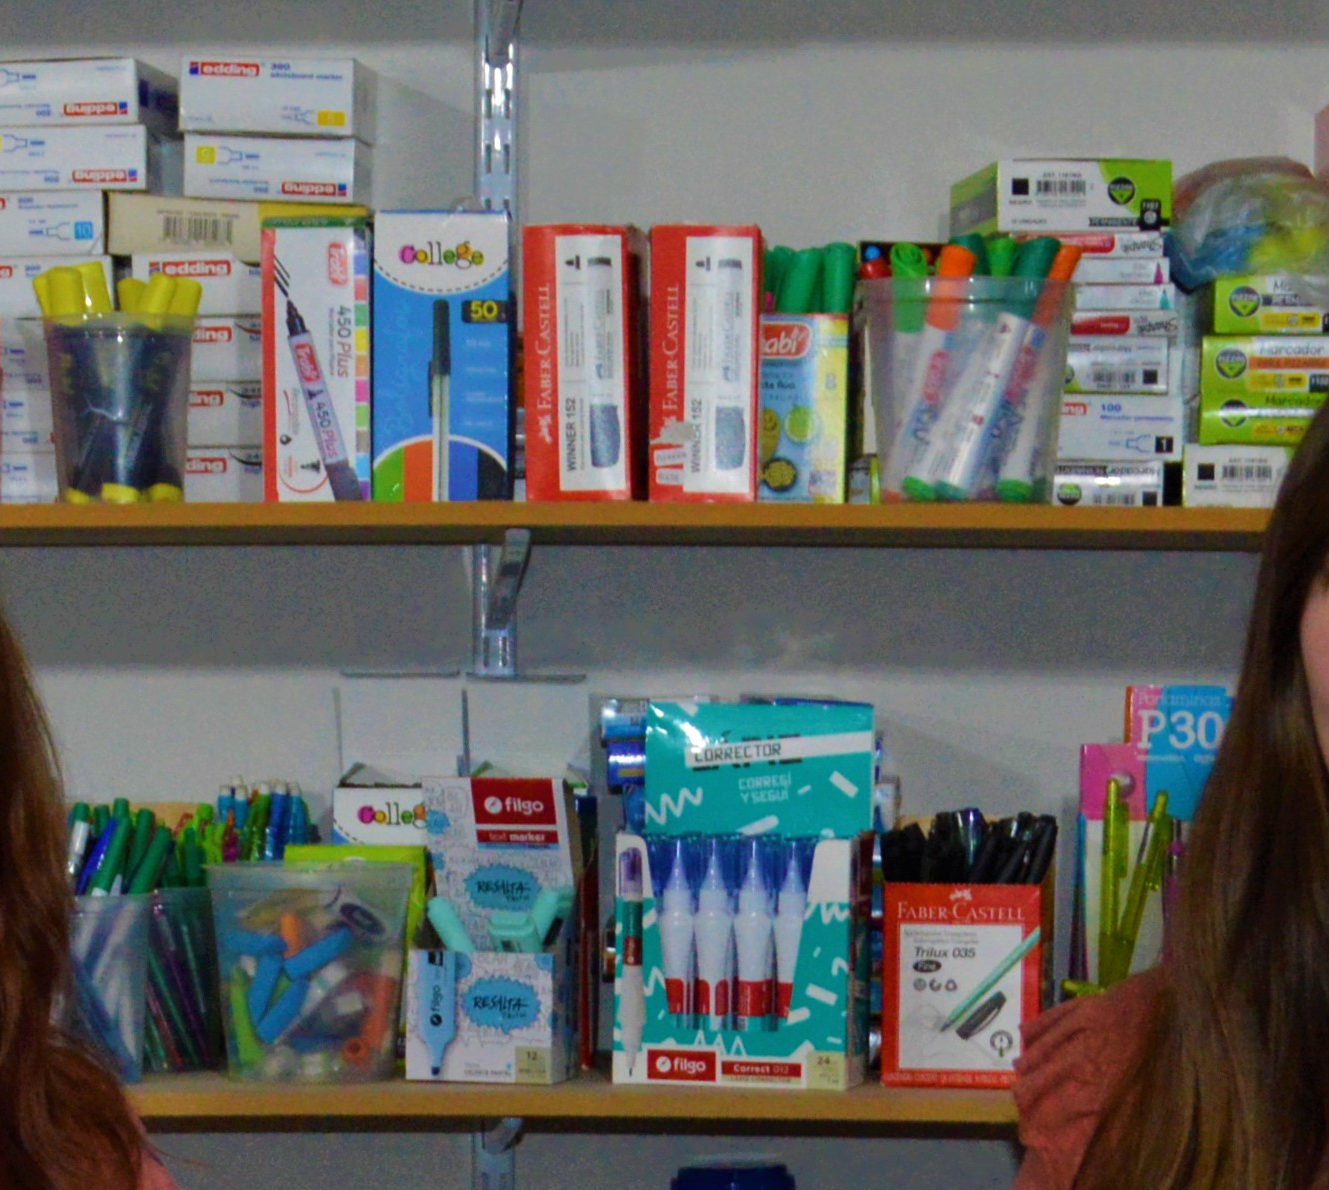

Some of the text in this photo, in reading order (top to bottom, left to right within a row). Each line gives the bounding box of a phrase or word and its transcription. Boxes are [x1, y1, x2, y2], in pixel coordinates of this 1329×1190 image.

[202, 65, 257, 76] edding
[66, 103, 115, 114] edding
[74, 171, 125, 182] edding
[283, 182, 335, 195] edding
[400, 242, 484, 268] College
[164, 261, 231, 275] edding
[471, 300, 498, 317] 50
[337, 305, 352, 377] 450 Plus
[536, 283, 552, 409] FABER-CASTELL
[662, 283, 679, 411] FABER-CASTELL
[1260, 344, 1324, 355] Marcador
[691, 400, 702, 426] 152
[1101, 403, 1122, 412] 100
[566, 398, 577, 471] WINNER 152
[1138, 710, 1223, 749] P30
[694, 742, 782, 762] CORRECTOR
[505, 795, 544, 815] filgo
[510, 831, 545, 843] marker
[897, 902, 1026, 921] FABER-CASTELL
[913, 946, 977, 959] Trilux 035
[431, 985, 443, 1012] filgo
[673, 1057, 707, 1075] filgo
[732, 1063, 770, 1074] Correct
[816, 1056, 831, 1066] 24
